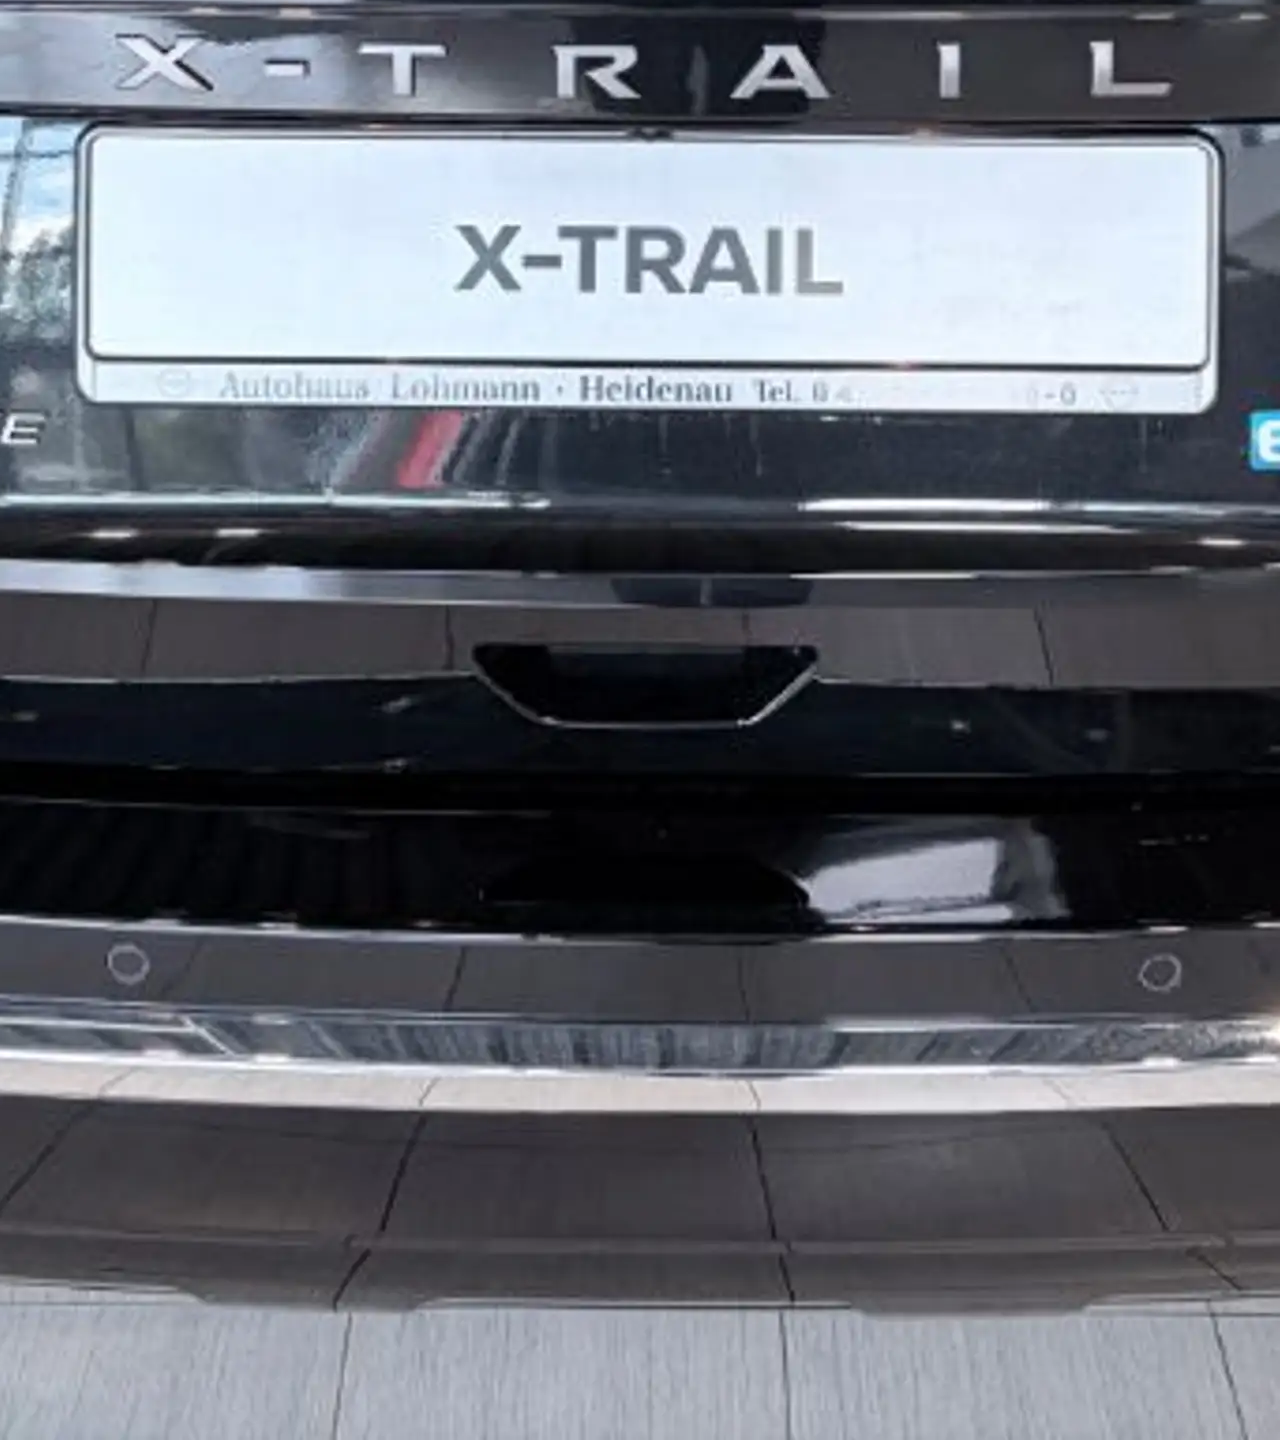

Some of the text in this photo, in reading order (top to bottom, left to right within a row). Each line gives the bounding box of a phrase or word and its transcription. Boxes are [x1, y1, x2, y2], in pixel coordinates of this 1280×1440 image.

[115, 37, 1174, 101] X-TRAIL
[454, 224, 844, 296] X-TRAIL
[219, 371, 370, 401] Autohaus
[390, 372, 541, 402] Lohmann
[578, 374, 733, 404] Heidenau
[754, 378, 802, 405] Tel.
